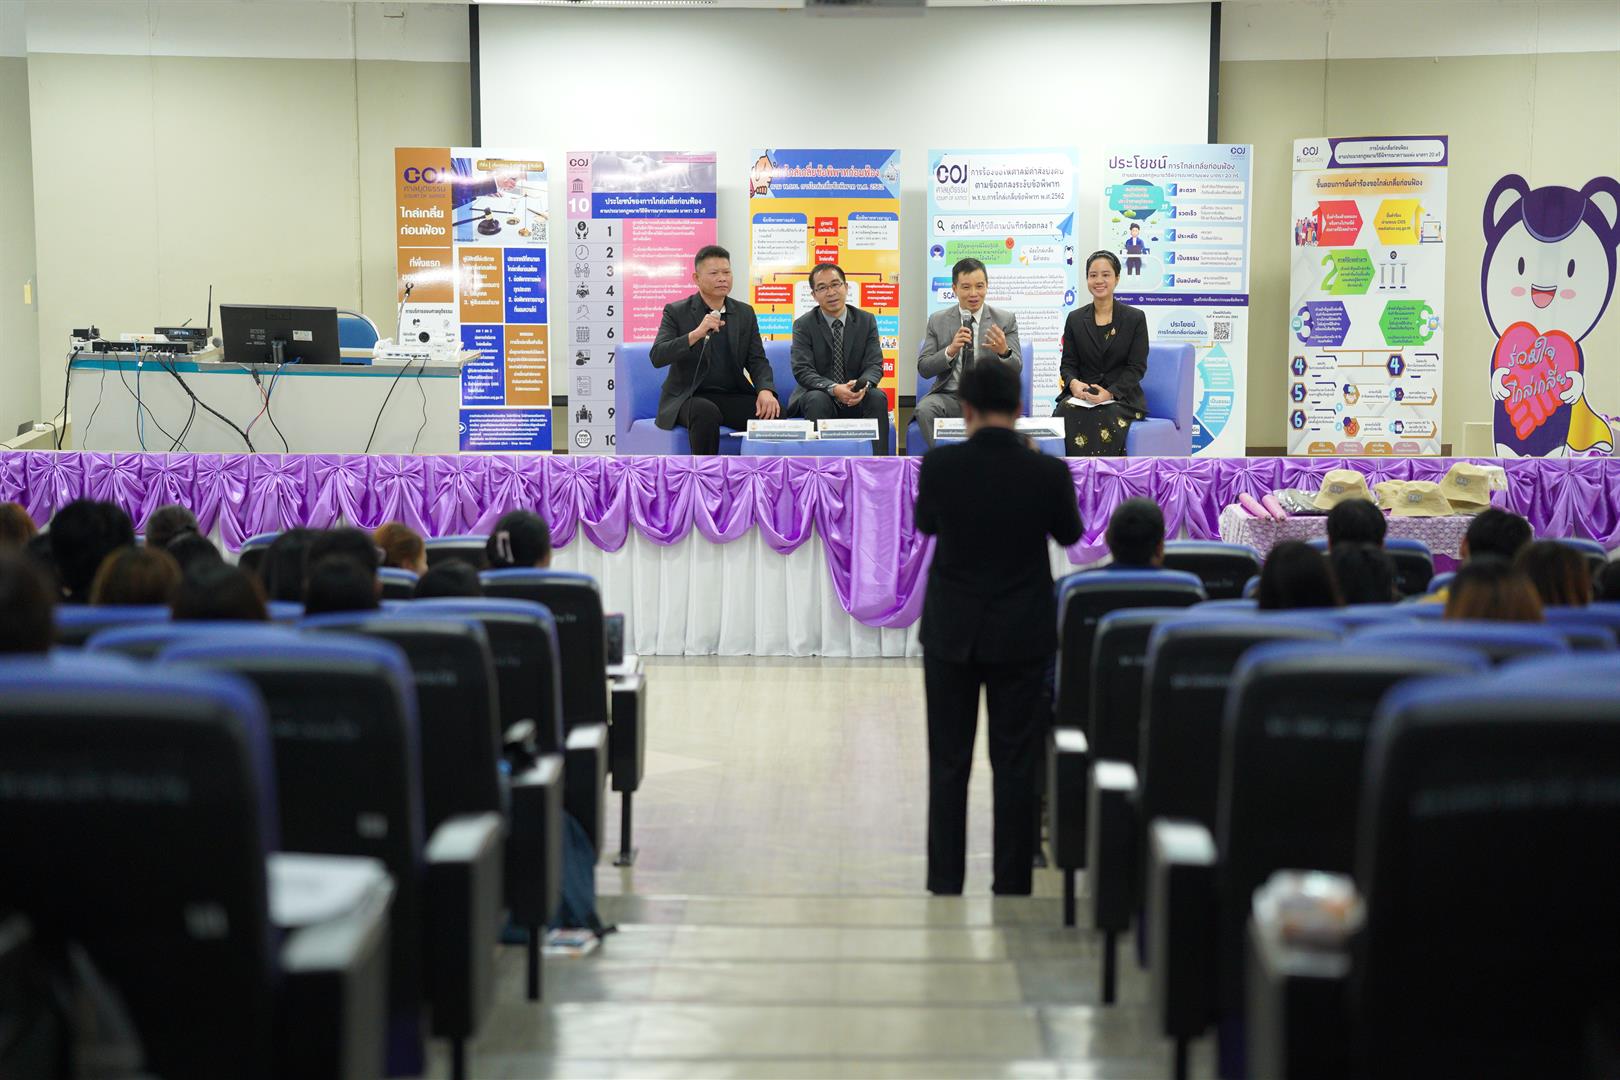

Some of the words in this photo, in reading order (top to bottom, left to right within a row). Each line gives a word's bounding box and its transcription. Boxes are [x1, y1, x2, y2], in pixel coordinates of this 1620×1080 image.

[1230, 147, 1246, 155] COJ
[1302, 146, 1319, 156] COJ
[569, 158, 589, 167] COJ
[1108, 155, 1168, 169] ประโยชน์
[1168, 161, 1236, 170] การไกล่เกลี่ยก่อนฟ้อง
[936, 164, 968, 184] COJ
[975, 179, 1060, 189] ตามข้อตกลงระงับข้อพิพาท
[568, 198, 590, 213] 10
[400, 205, 445, 219] ไกล่เกลี่ย
[1178, 208, 1198, 217] รวดเร็ว
[400, 224, 446, 236] ก่อนฟ้อง
[607, 226, 612, 237] 1
[1177, 232, 1198, 240] ประหยัด
[606, 247, 614, 259] 2
[1176, 253, 1200, 262] เป็นธรรม
[606, 266, 614, 277] 3
[605, 285, 615, 296] 4
[606, 305, 614, 317] 5
[1170, 320, 1196, 329] ประโยชน์
[606, 327, 615, 339] 6
[1508, 336, 1555, 367] ร่วมใจ
[607, 352, 615, 364] 7
[1294, 358, 1304, 375] 4
[1389, 357, 1400, 375] 4
[607, 379, 615, 391] 8
[1505, 364, 1567, 404] ไกล่เกลี่ย
[1294, 383, 1303, 401] 5
[607, 408, 616, 419] 9
[1294, 411, 1303, 429] 6
